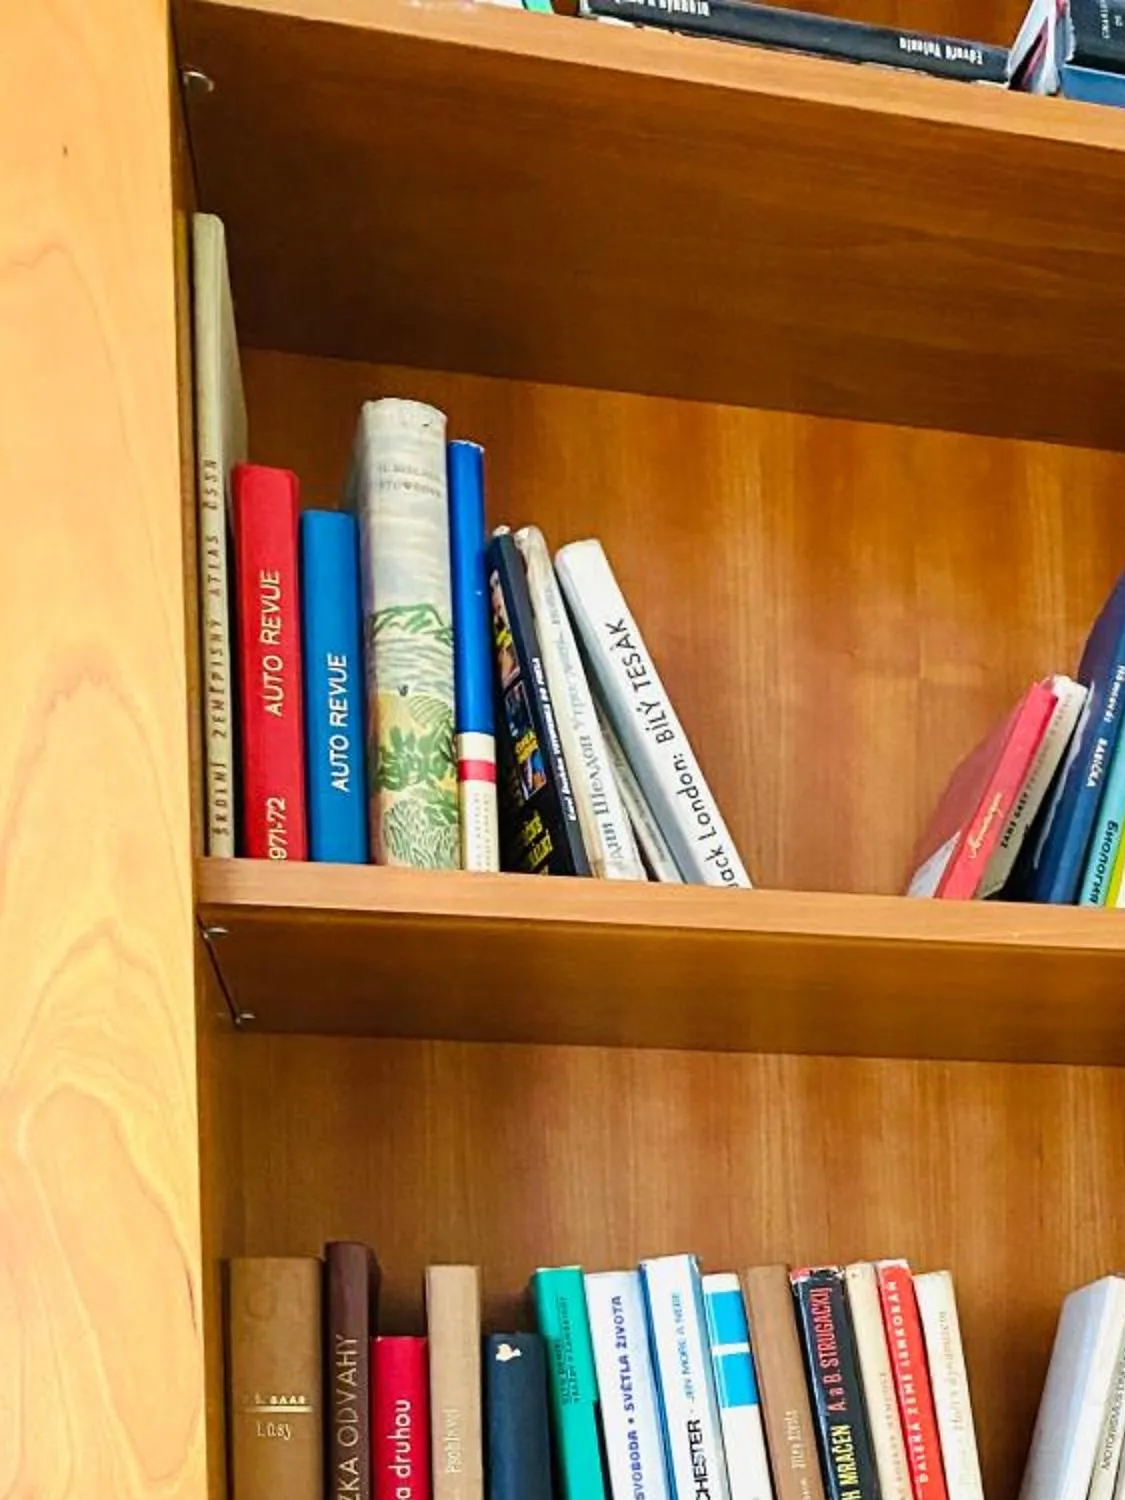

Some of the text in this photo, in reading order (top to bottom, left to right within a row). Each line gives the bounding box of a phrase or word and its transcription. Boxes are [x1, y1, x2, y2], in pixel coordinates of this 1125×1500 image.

[258, 567, 284, 716] AUTO REVUE
[325, 650, 350, 793] AUTO REVUE
[266, 795, 288, 858] 971-72
[668, 750, 718, 842] London:
[608, 1293, 628, 1350] ŽIVOTA
[333, 1336, 360, 1447] ODVAHY
[615, 1354, 635, 1414] SVĚTLA
[386, 1398, 412, 1478] druhou
[625, 1428, 645, 1500] SVOBODA
[826, 1422, 860, 1487] MRAČEN
